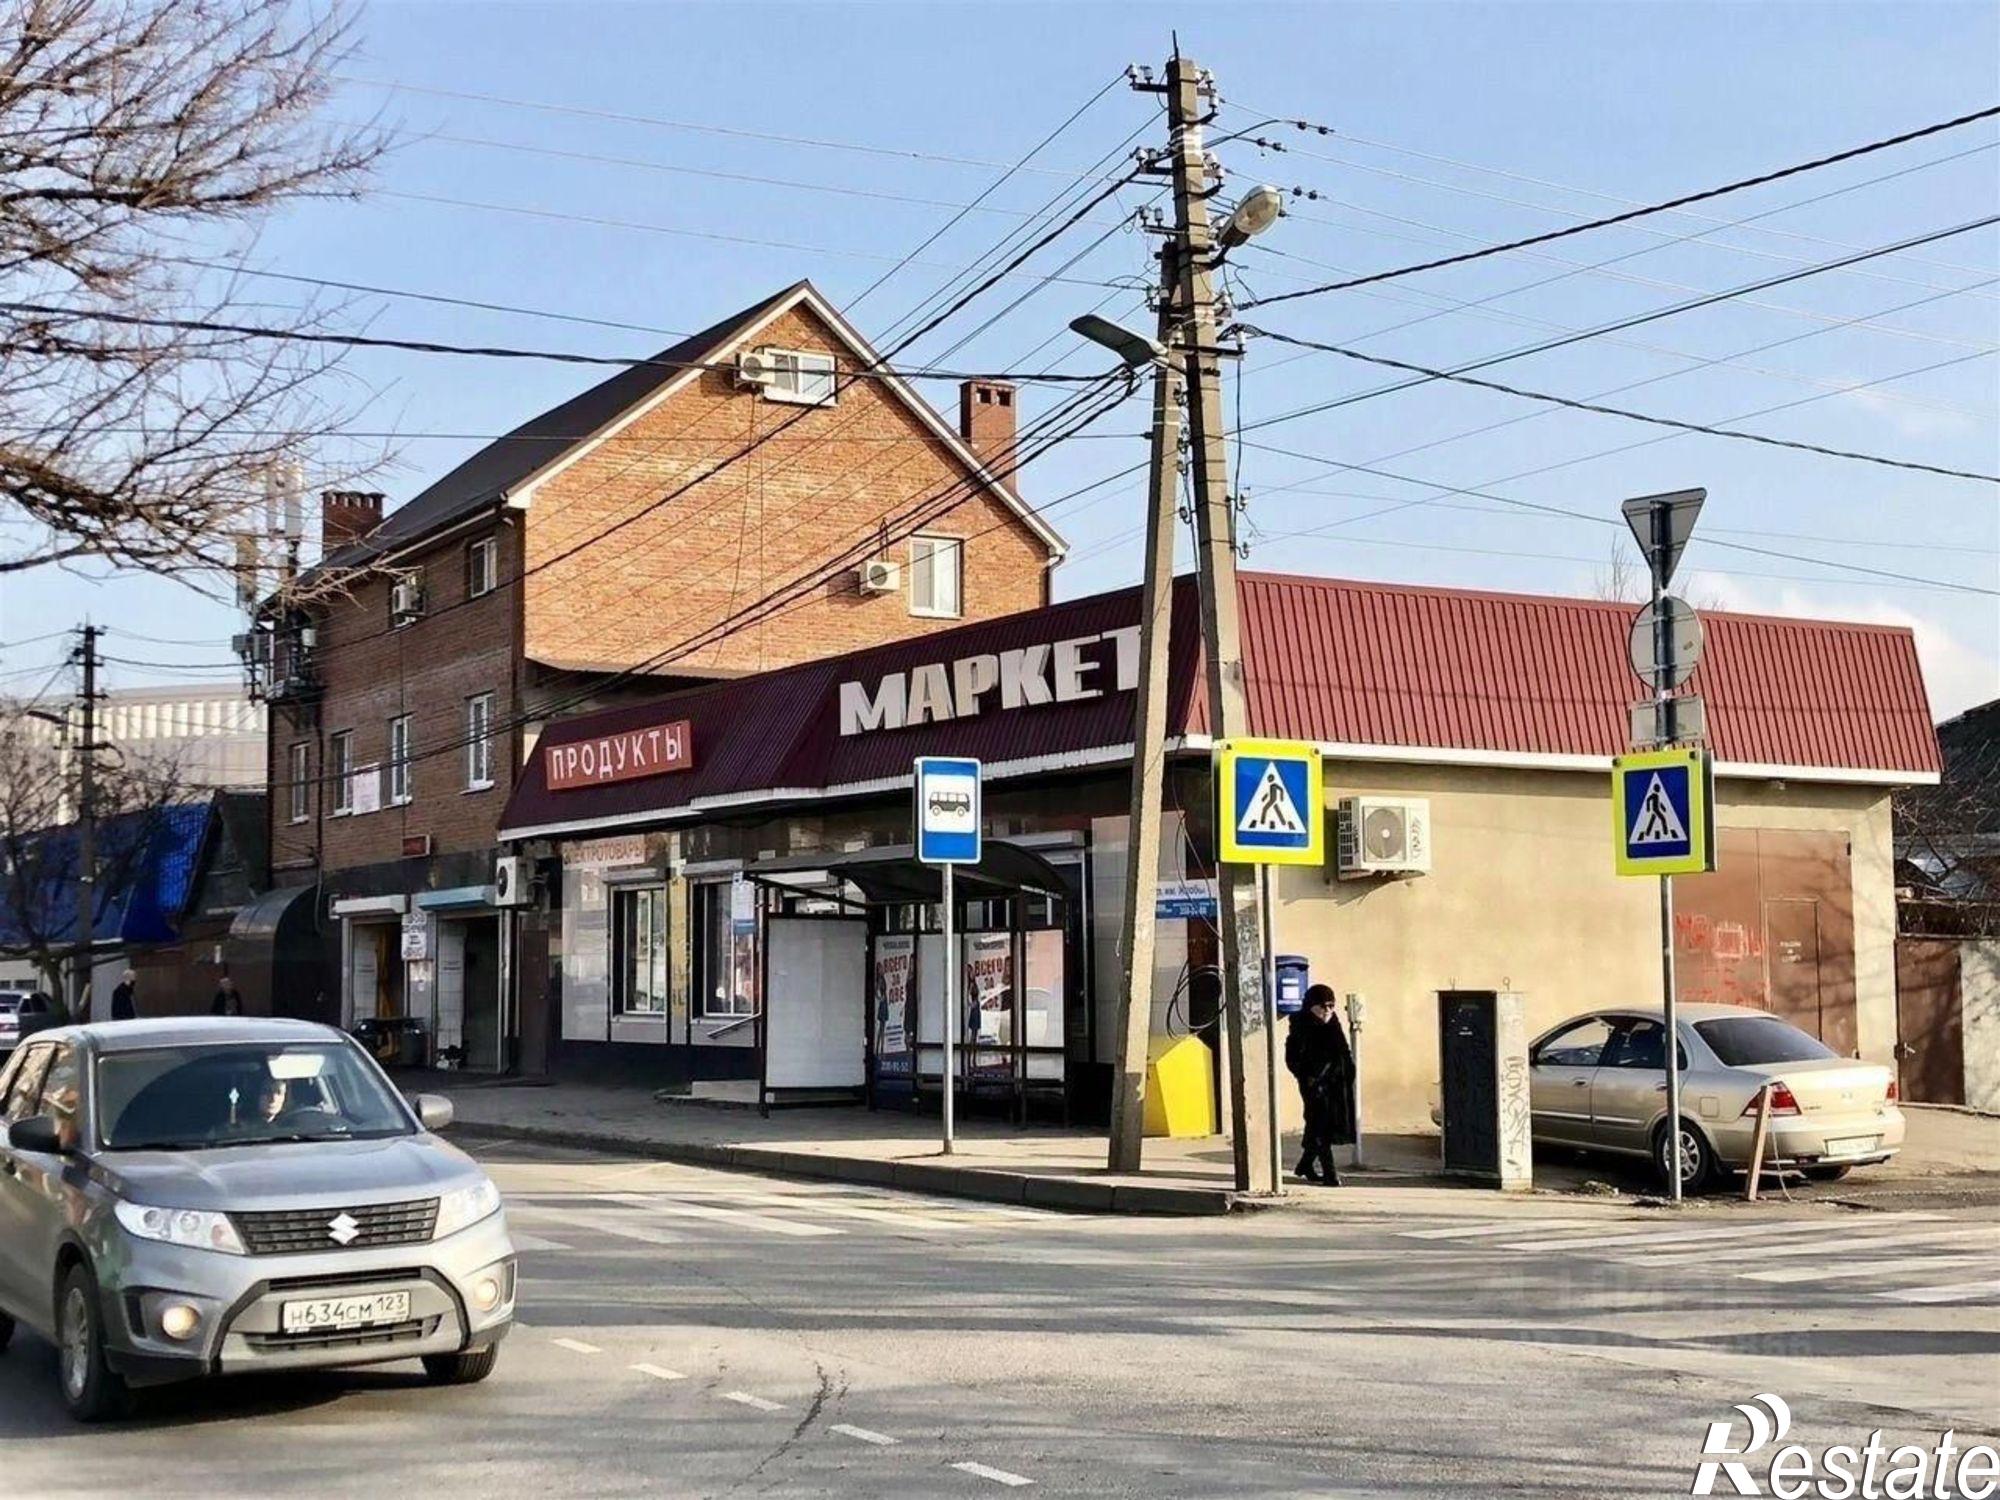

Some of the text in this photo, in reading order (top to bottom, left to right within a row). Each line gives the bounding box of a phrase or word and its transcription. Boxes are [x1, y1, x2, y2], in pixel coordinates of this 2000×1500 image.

[840, 625, 1141, 736] МАРКЕТ
[552, 726, 682, 780] ПРОДУКТЫ
[290, 1294, 404, 1326] Н634СМ 123
